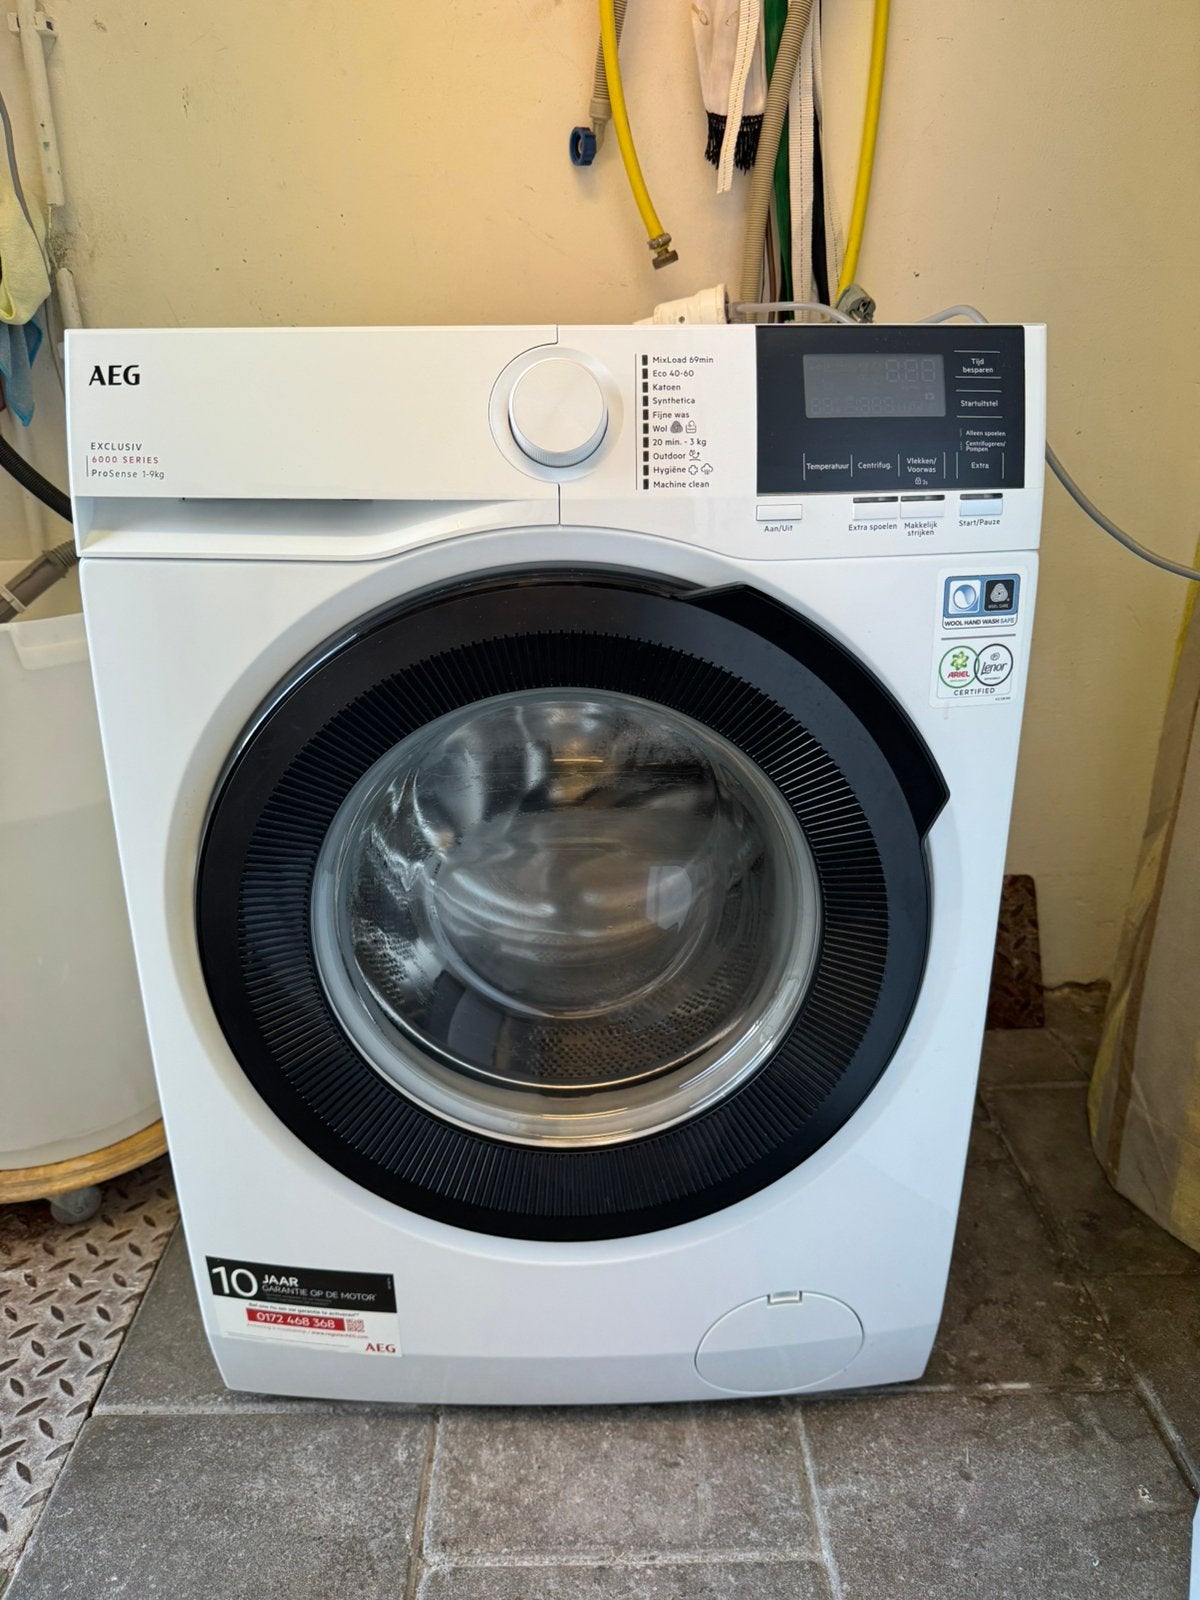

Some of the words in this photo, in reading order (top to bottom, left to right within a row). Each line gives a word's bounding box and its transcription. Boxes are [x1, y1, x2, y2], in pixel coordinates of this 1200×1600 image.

[971, 358, 985, 366] Tijd
[962, 366, 994, 374] besparen
[88, 364, 140, 386] AEG
[652, 396, 696, 405] Synthetica
[652, 411, 672, 420] Fijne
[90, 442, 142, 451] EXCLUSIV
[652, 438, 663, 446] 20
[665, 438, 682, 446] min.
[696, 438, 707, 447] kg
[92, 456, 118, 464] 6000
[123, 456, 159, 464] SERIES
[653, 452, 686, 460] Outdoor
[906, 457, 937, 465] Vlekken/
[653, 466, 686, 475] Hygiëne
[806, 463, 849, 471] Temperatuur
[857, 462, 893, 470] Centrifug.
[91, 469, 138, 478] ProSense
[142, 470, 165, 480] 1-9kg
[869, 523, 898, 532] spoelen
[904, 521, 938, 530] Makkelijk
[959, 519, 1000, 527] Start/Pauze
[907, 529, 935, 537] strijken
[980, 662, 1008, 675] Lenor
[953, 687, 996, 696] CERTIFIED
[212, 1266, 258, 1297] 10
[262, 1274, 299, 1287] JAAR
[262, 1285, 309, 1296] GARANTIE
[310, 1289, 324, 1297] OP
[326, 1290, 339, 1299] DE
[256, 1312, 284, 1323] 0172
[286, 1315, 310, 1326] 468
[312, 1317, 336, 1329] 368
[365, 1343, 396, 1354] AEG
